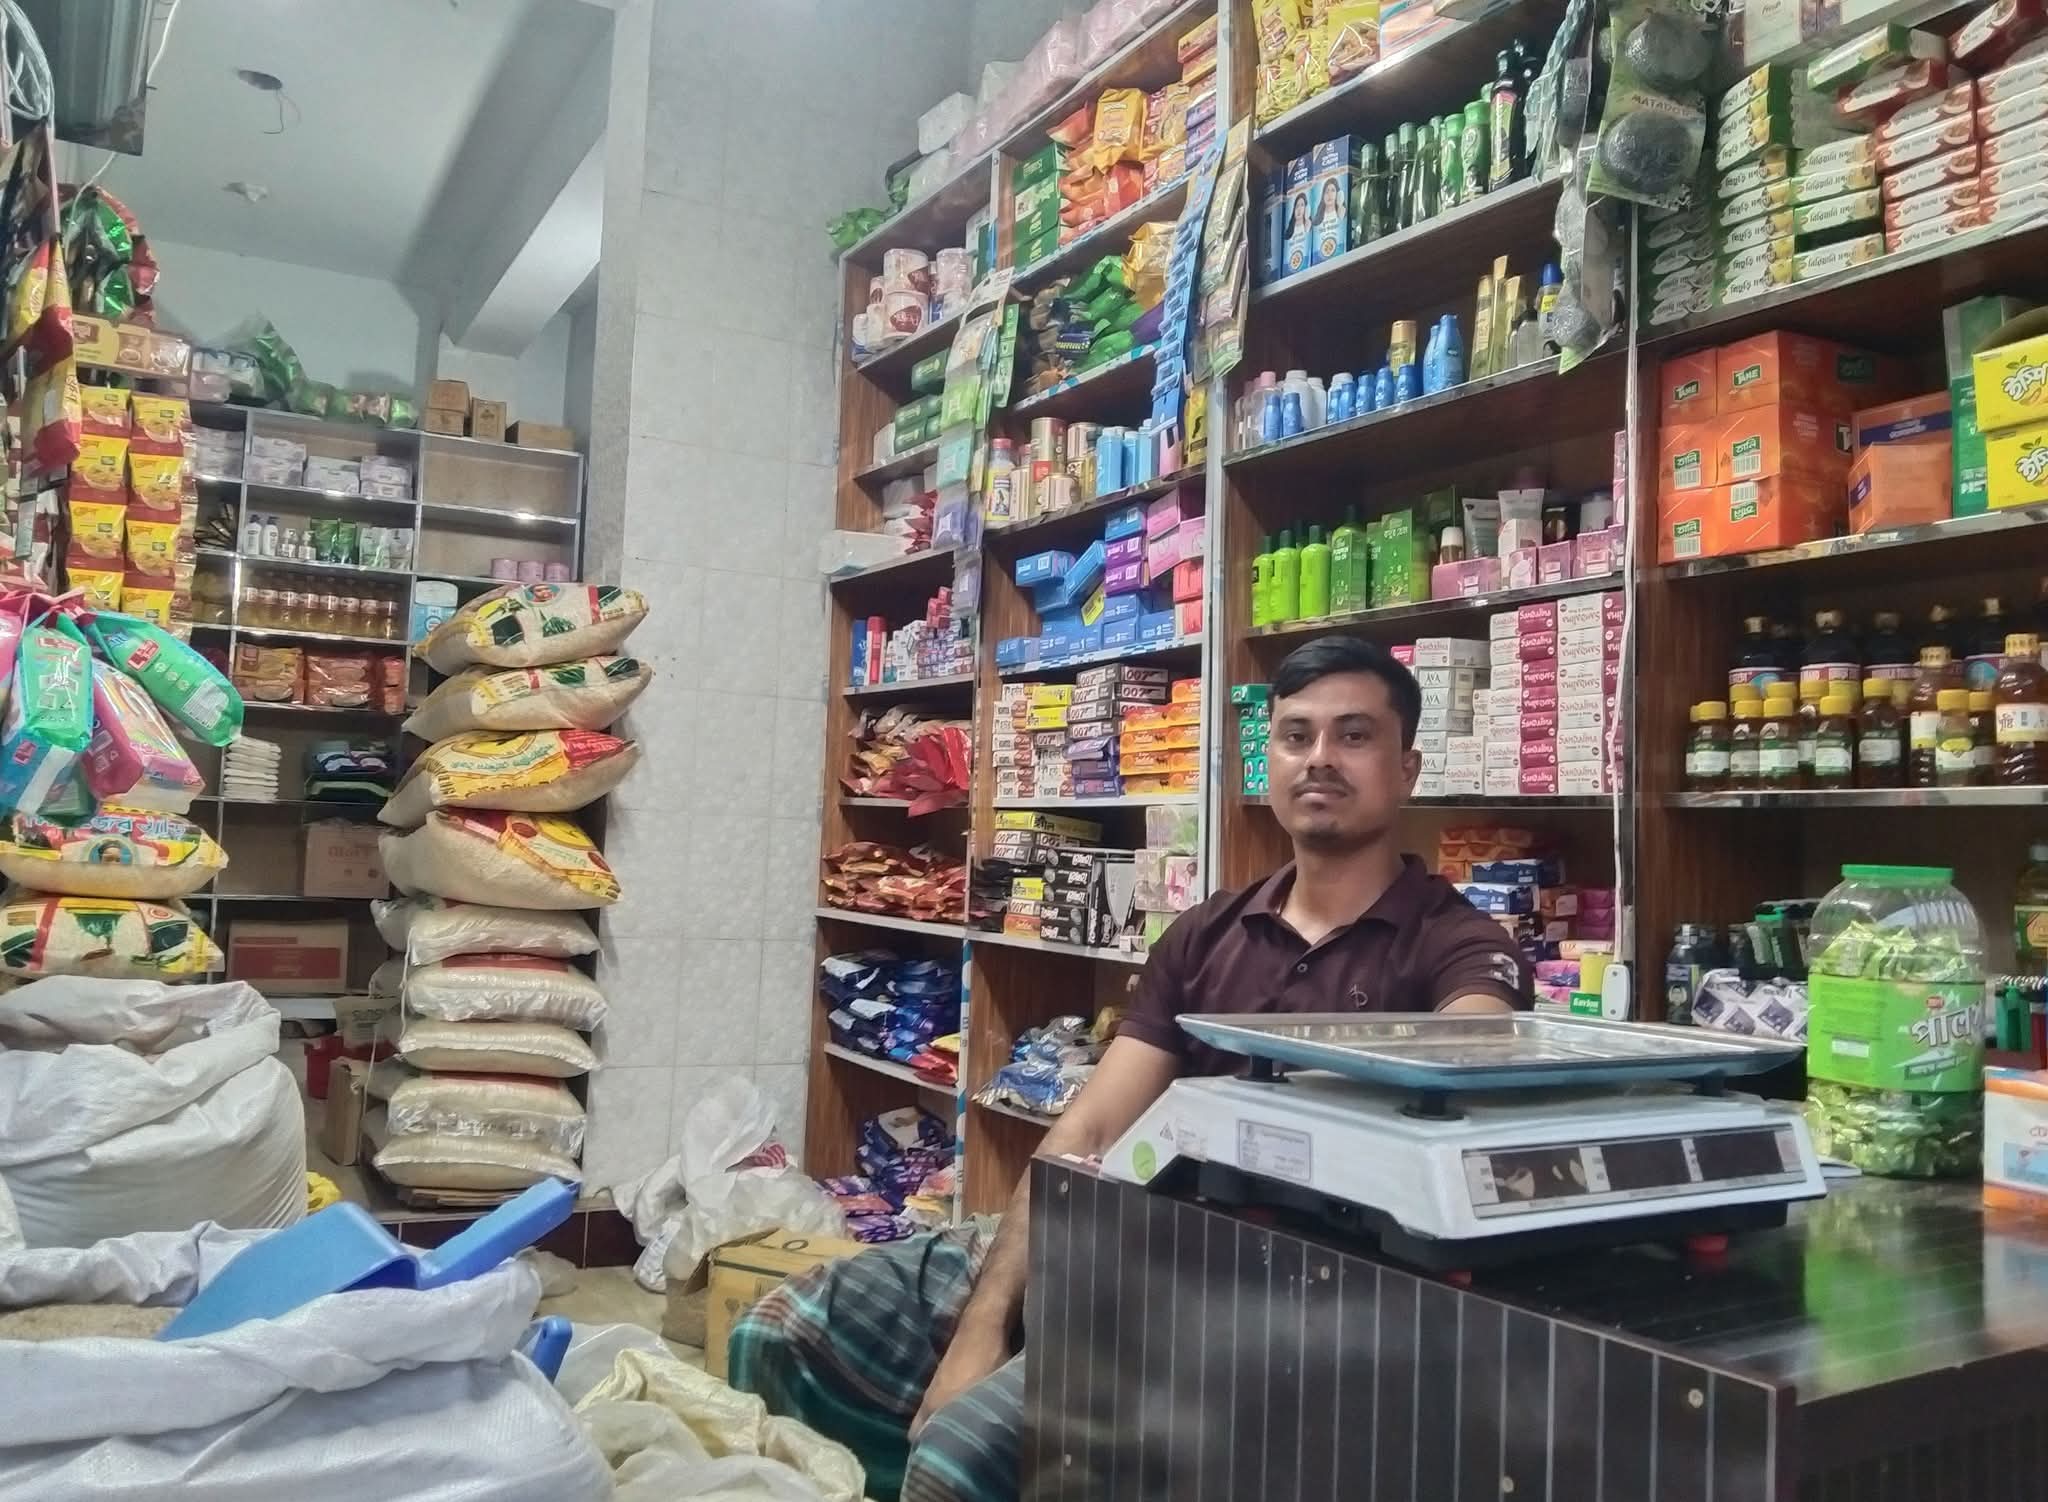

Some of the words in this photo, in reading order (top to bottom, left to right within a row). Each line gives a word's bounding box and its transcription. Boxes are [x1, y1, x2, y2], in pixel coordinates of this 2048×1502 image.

[1520, 607, 1552, 620] Sandalina
[1521, 635, 1553, 648] Sandalina
[1081, 675, 1096, 686] 007
[1127, 669, 1149, 681] 007
[1426, 671, 1441, 683] AVA
[1122, 686, 1147, 697] 007
[1424, 694, 1440, 705] AVA
[1560, 699, 1599, 712] Sandalina
[1521, 717, 1553, 728] Sandalina
[1073, 725, 1089, 738] 007
[1559, 734, 1598, 745] Sandalina
[1521, 743, 1554, 755] Sandalina
[1559, 765, 1598, 777] Sandalina
[1521, 772, 1553, 783] Sandalina
